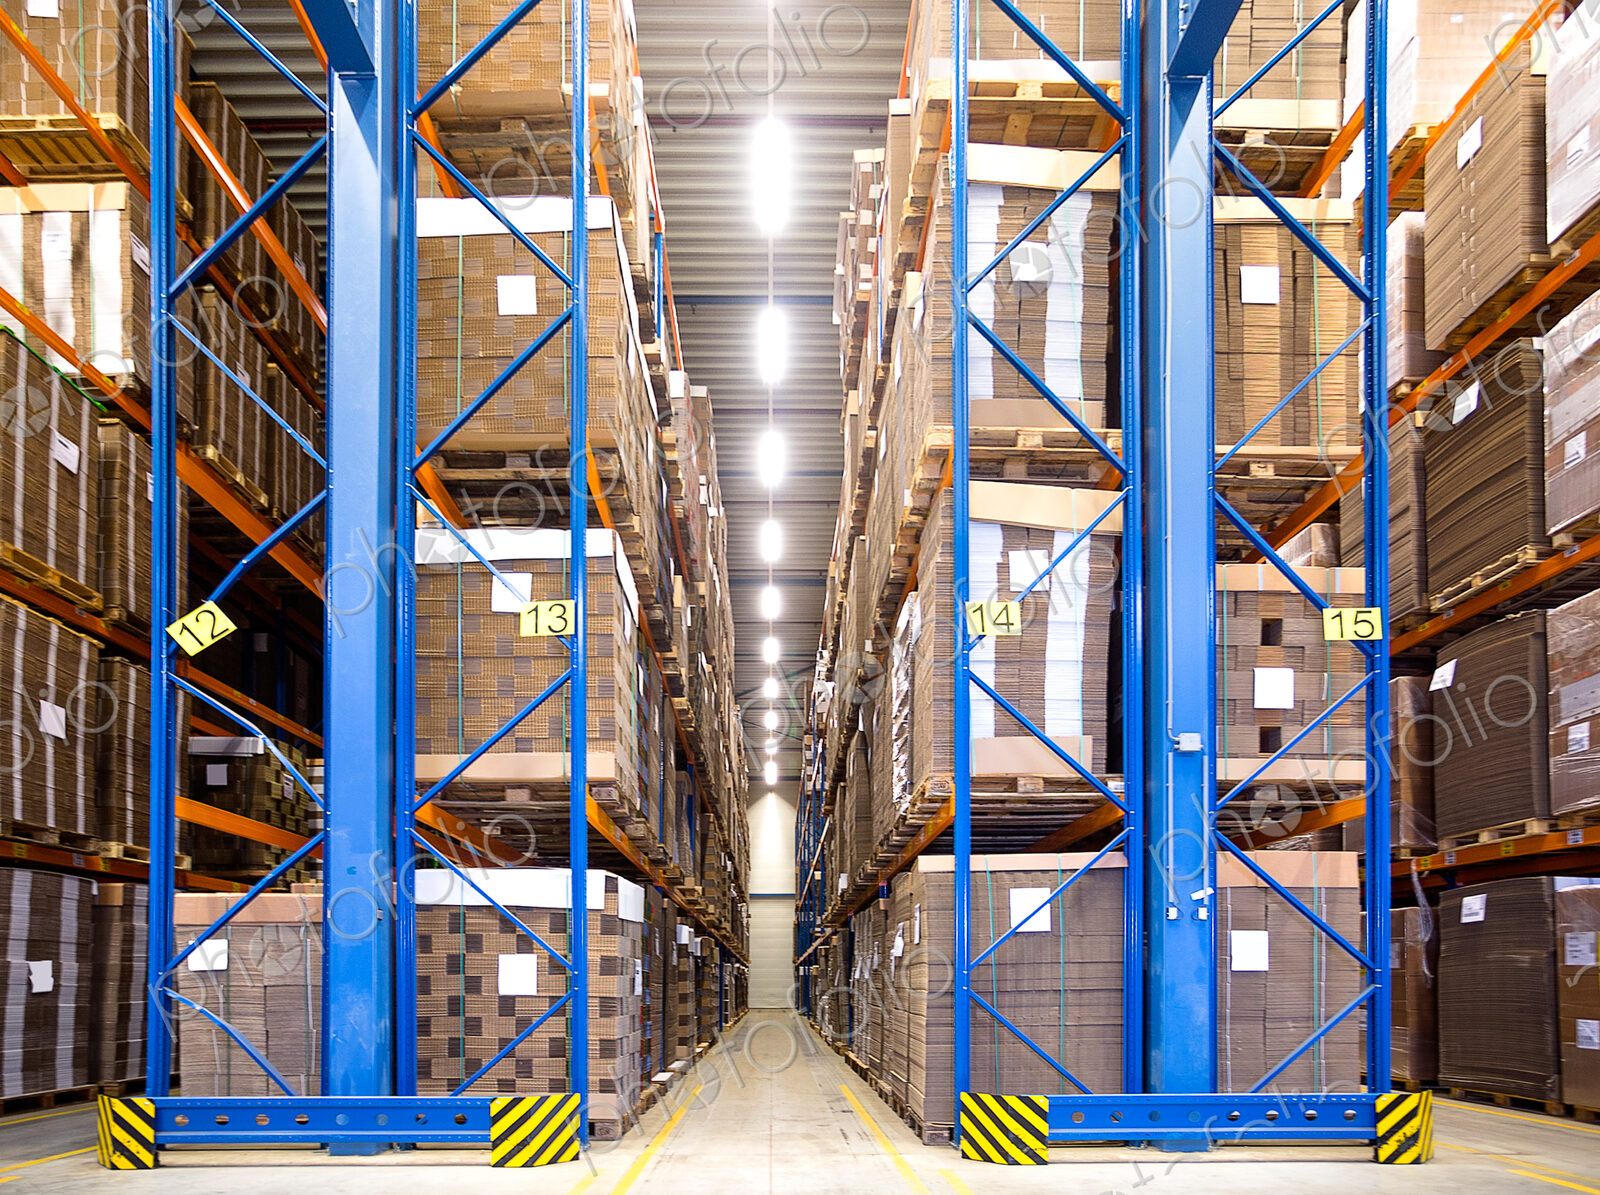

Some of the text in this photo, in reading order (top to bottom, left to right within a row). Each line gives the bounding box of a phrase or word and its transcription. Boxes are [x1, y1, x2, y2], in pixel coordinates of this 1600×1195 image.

[179, 609, 230, 647] 12
[527, 603, 568, 634] 13
[972, 603, 1014, 633] 14
[1331, 610, 1375, 639] 15
